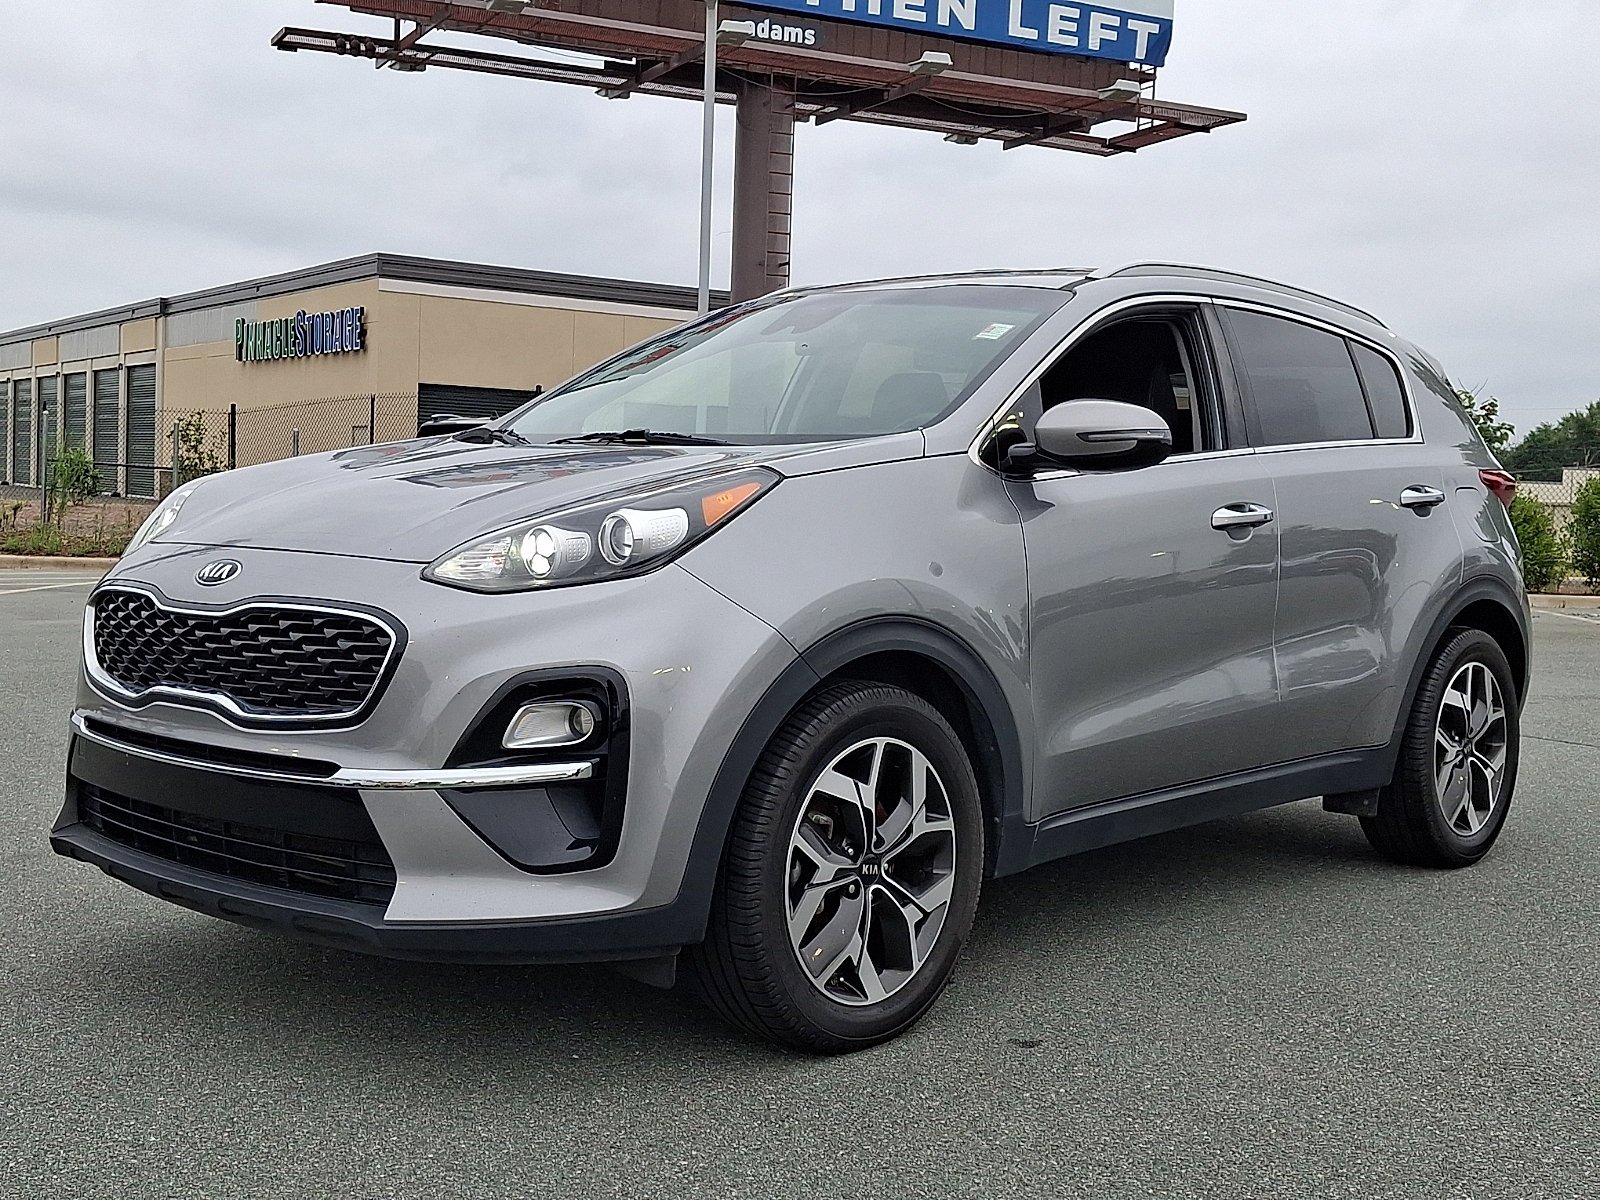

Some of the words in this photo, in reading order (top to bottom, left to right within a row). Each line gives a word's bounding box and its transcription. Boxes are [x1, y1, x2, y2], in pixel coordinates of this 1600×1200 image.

[806, 0, 975, 31] EN
[1008, 0, 1160, 60] LEFT
[199, 562, 233, 580] KIA
[862, 864, 878, 875] KIA
